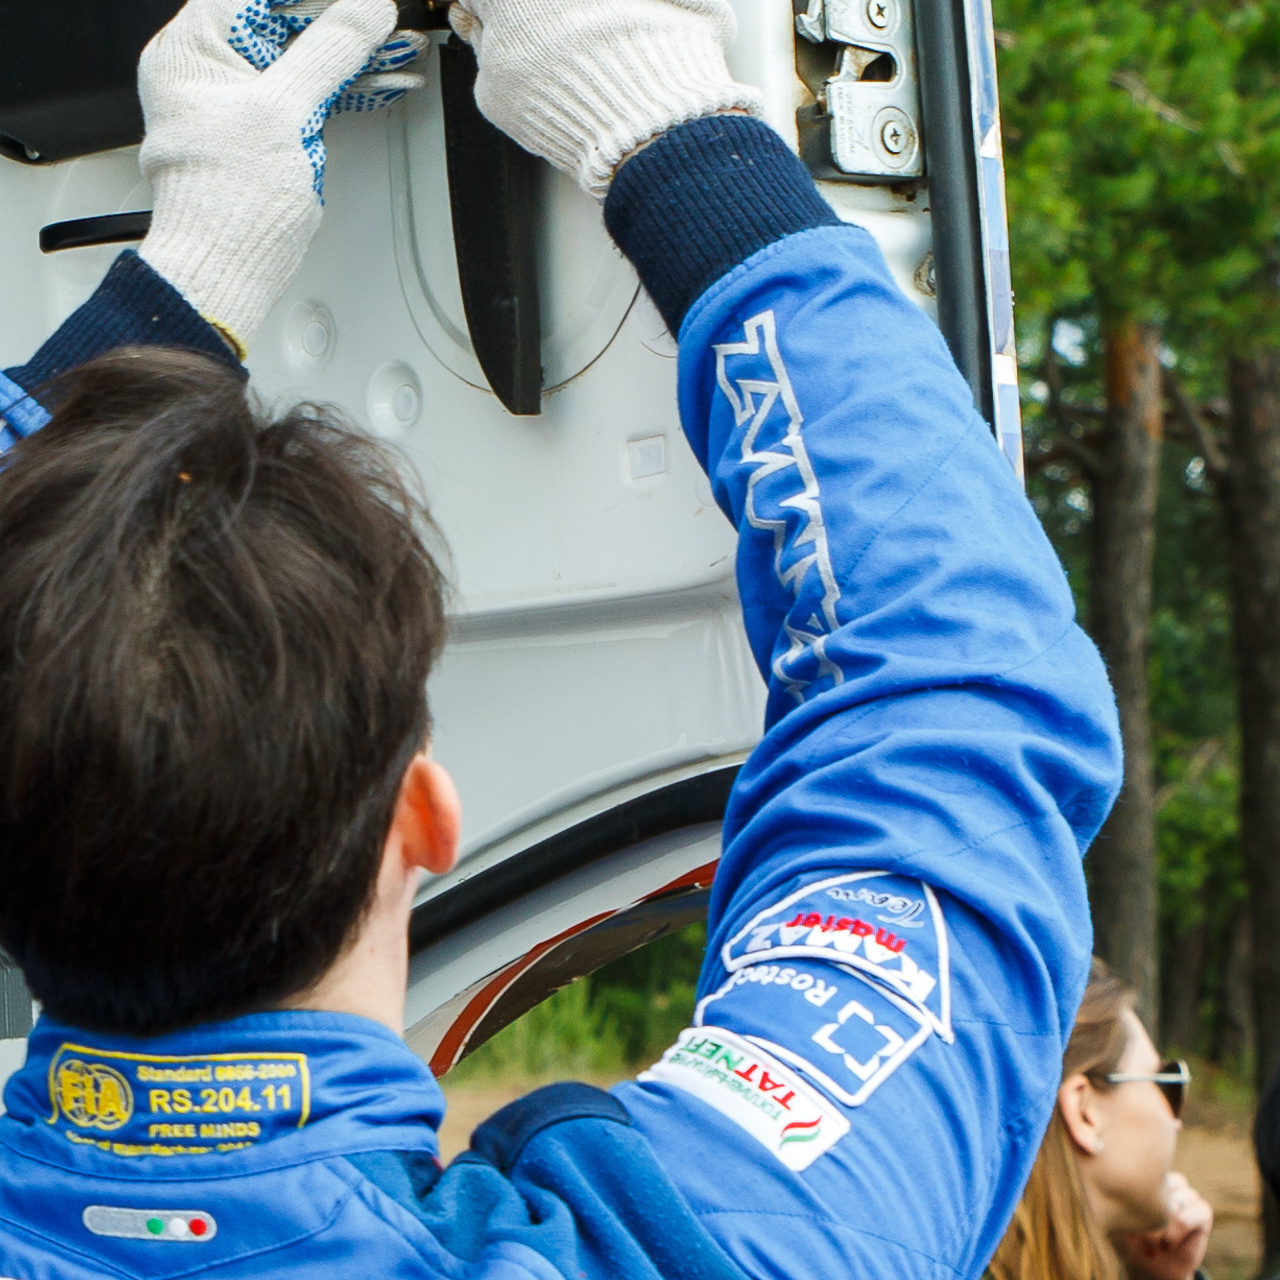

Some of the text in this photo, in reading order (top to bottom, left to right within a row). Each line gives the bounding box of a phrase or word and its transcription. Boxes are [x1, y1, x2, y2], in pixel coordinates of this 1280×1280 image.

[785, 911, 907, 953] master
[745, 922, 937, 1003] KAMAZ
[735, 965, 838, 1007] Rostec
[136, 1065, 212, 1082] Standard
[678, 1035, 796, 1111] TATNEFT
[60, 1069, 128, 1121] FIA
[149, 1084, 291, 1114] RS.204.11
[148, 1121, 261, 1138] FREE MINDS
